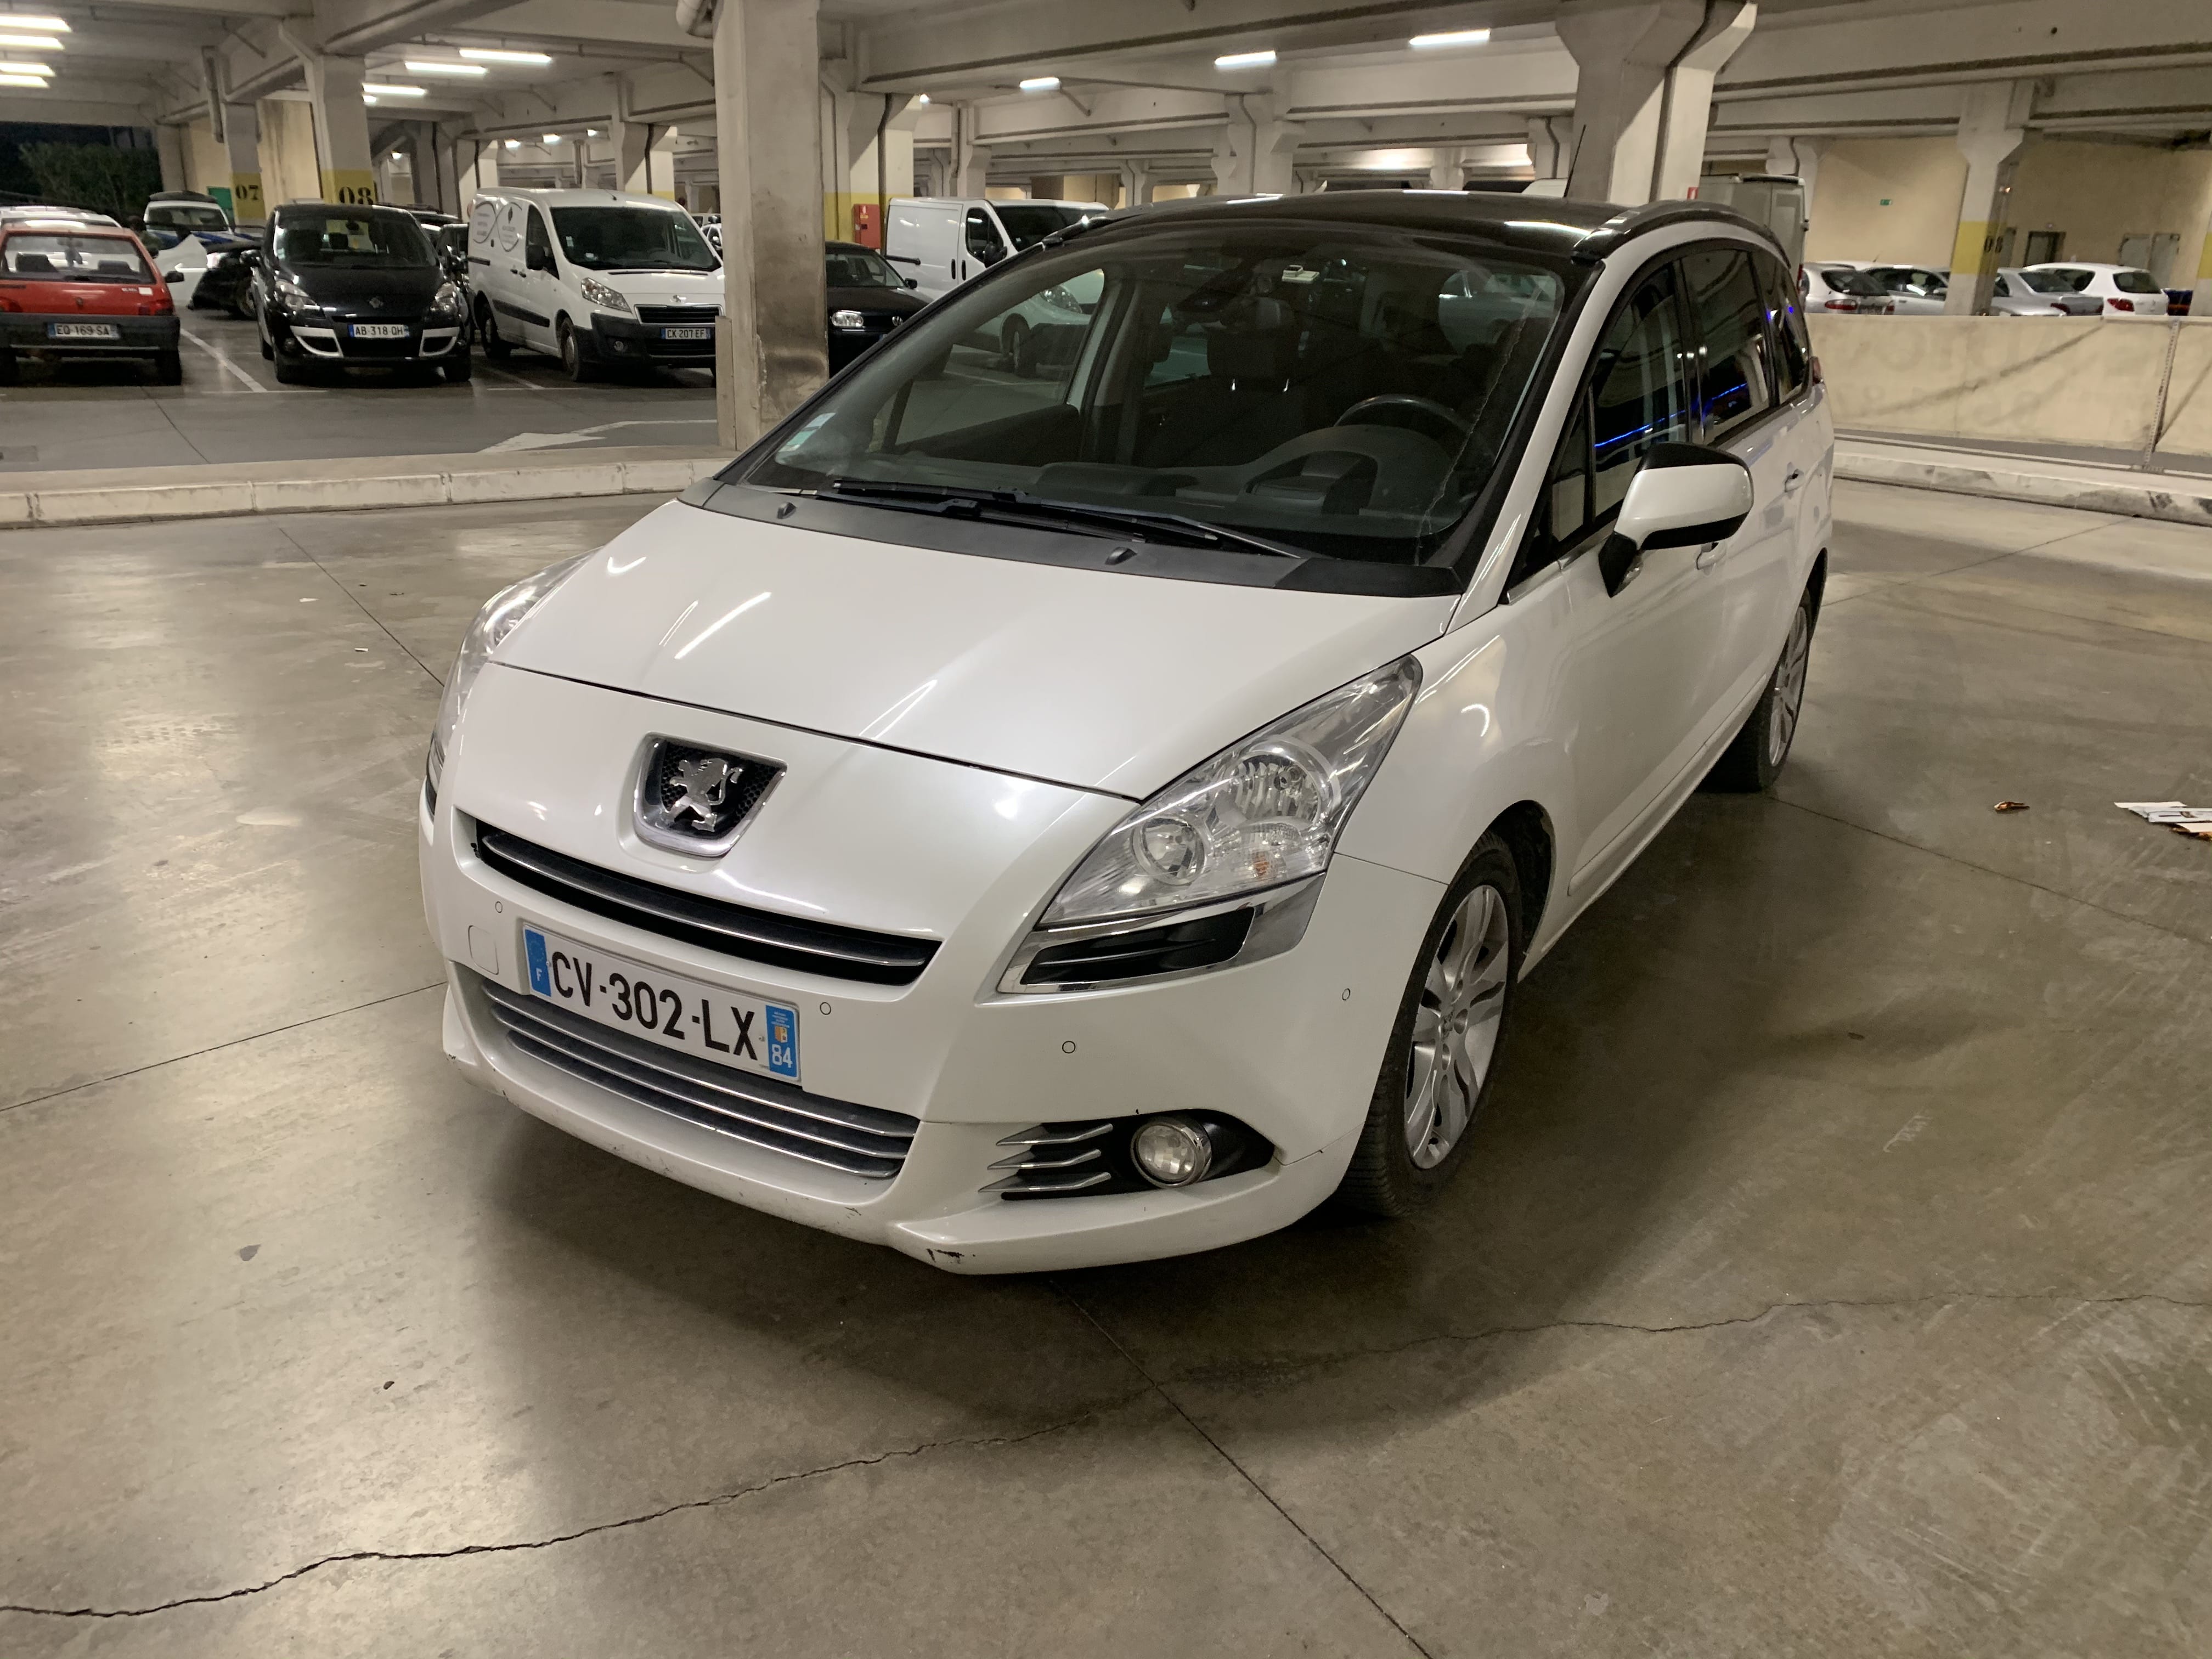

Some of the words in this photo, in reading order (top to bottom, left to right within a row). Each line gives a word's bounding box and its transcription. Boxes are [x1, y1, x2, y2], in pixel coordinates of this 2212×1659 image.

[235, 184, 259, 200] 07
[338, 187, 374, 205] 08
[535, 967, 543, 981] F
[551, 951, 758, 1061] CV-302-LX
[771, 1043, 793, 1069] 84
